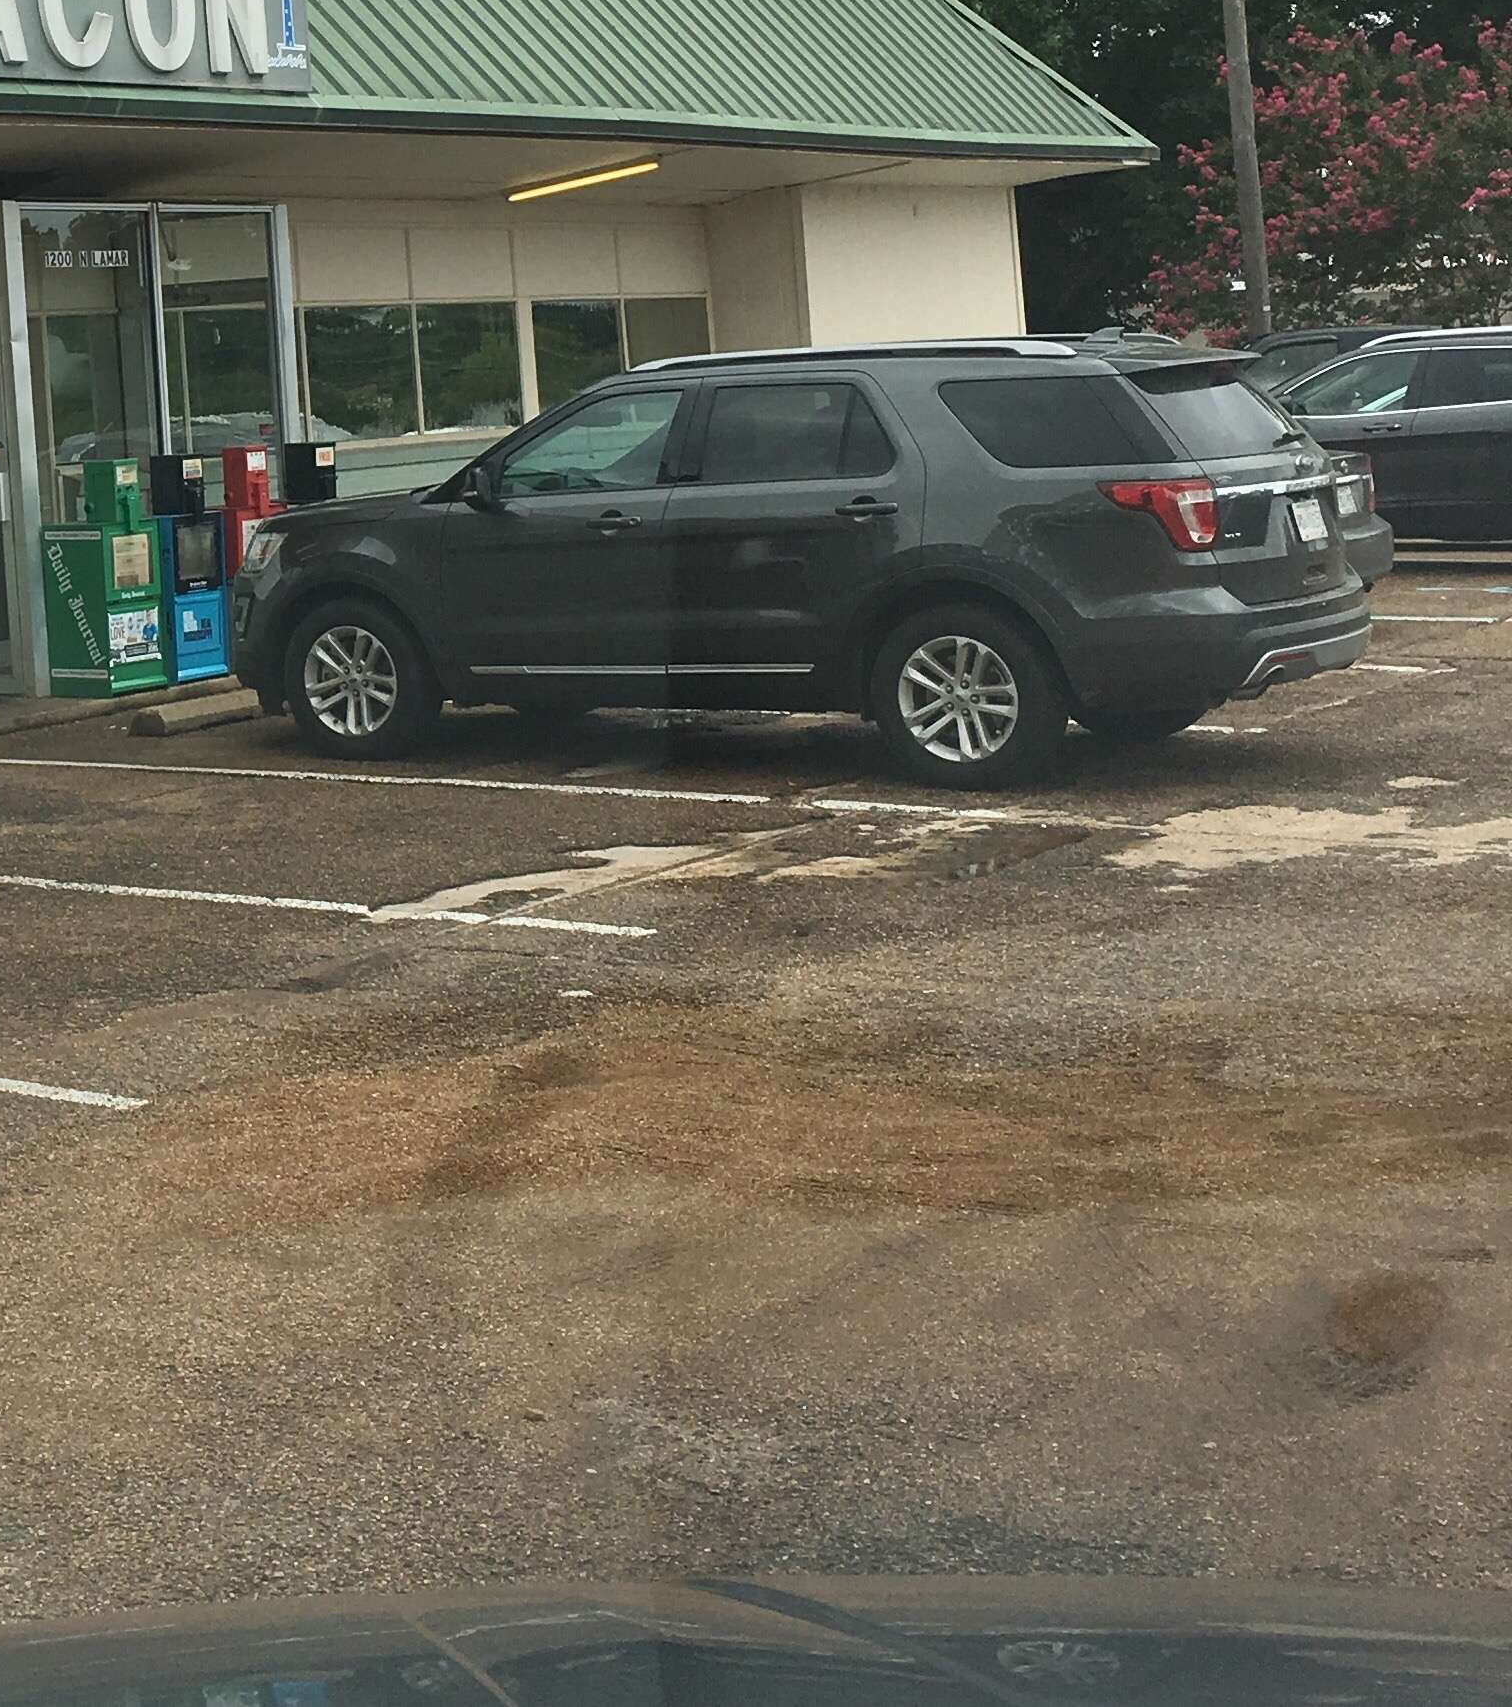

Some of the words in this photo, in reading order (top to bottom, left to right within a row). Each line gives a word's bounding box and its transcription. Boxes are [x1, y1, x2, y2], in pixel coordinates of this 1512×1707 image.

[45, 251, 72, 267] 1200
[79, 251, 88, 267] N
[91, 250, 129, 267] LAMAR
[46, 542, 73, 594] Daily
[67, 593, 107, 666] Journal
